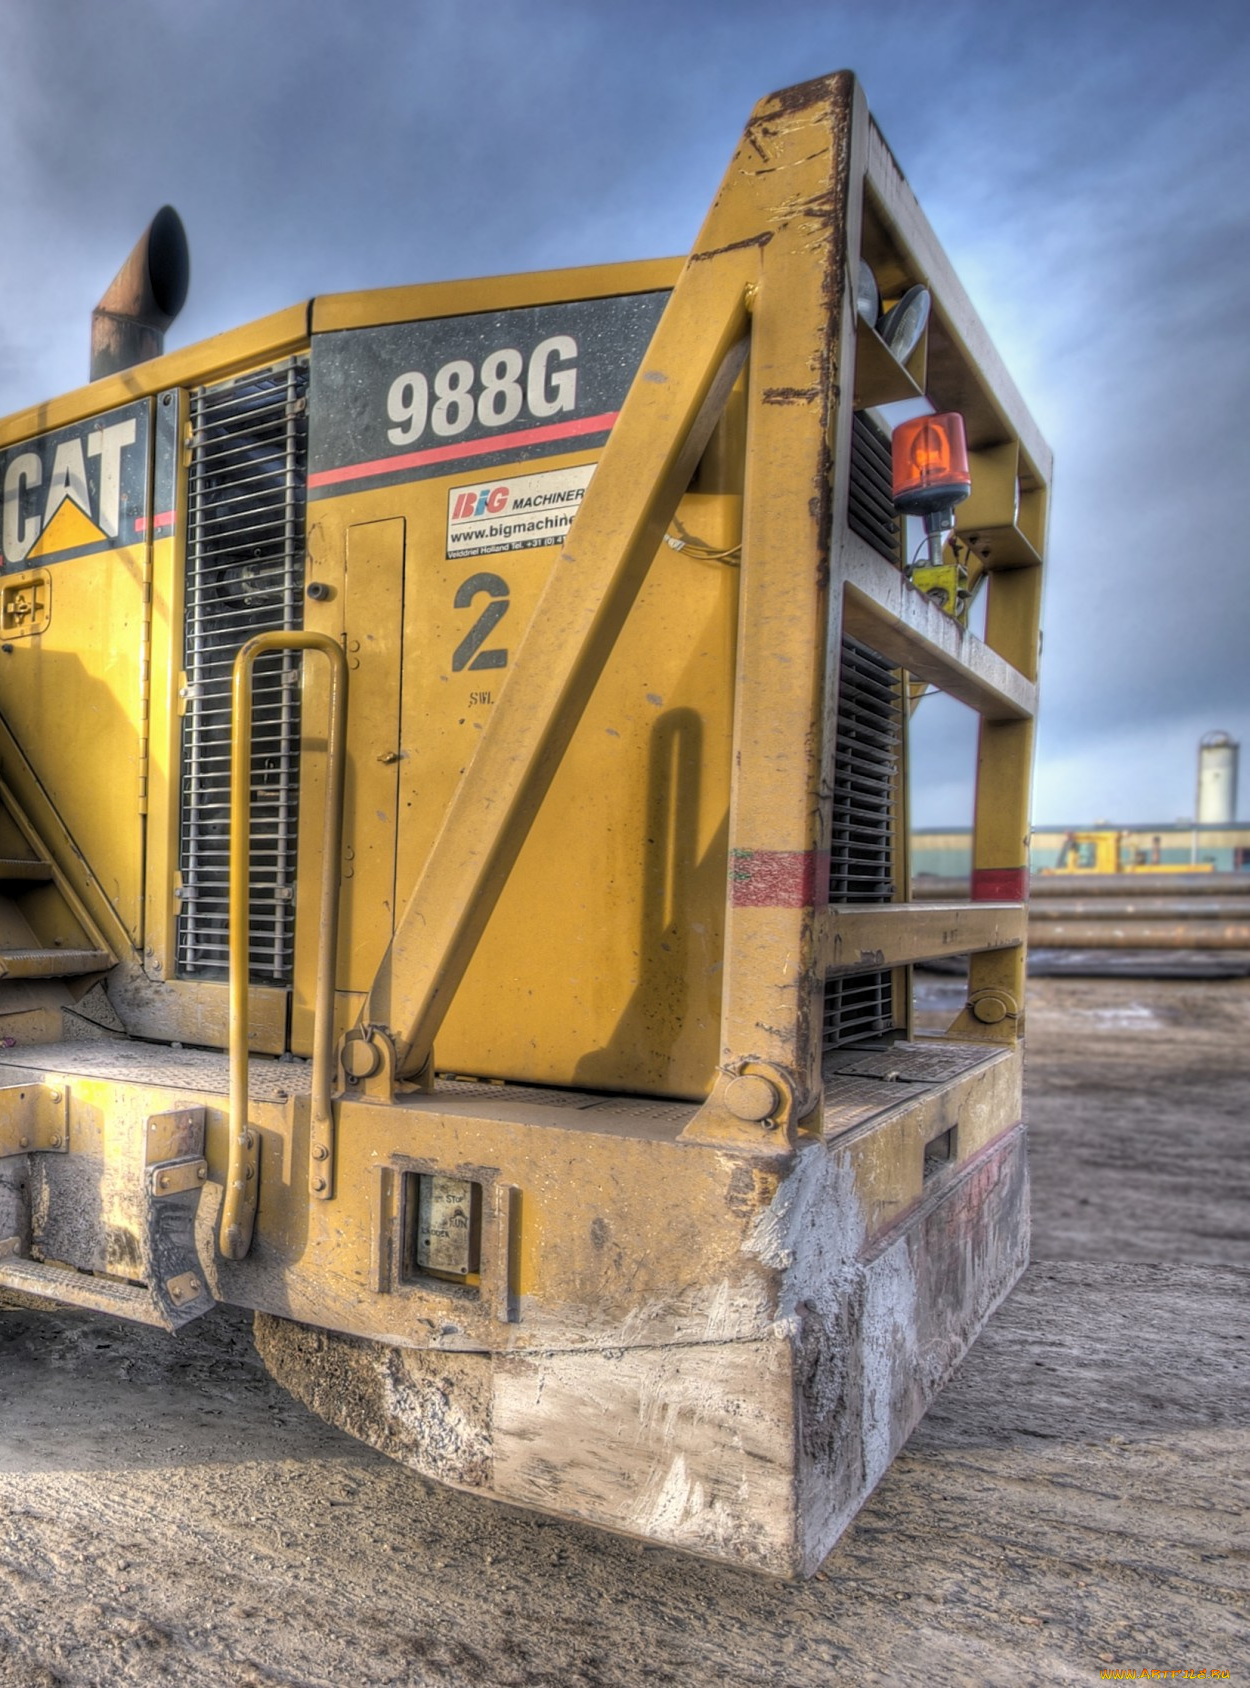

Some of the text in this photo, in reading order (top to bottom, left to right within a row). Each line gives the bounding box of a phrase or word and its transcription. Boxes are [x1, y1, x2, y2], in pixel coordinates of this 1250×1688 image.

[386, 334, 579, 446] 988G
[3, 418, 137, 563] CAT
[512, 488, 586, 511] MACHINER
[450, 514, 576, 543] www.bigmachin
[480, 543, 510, 554] Holland
[511, 542, 524, 550] Tel.
[526, 539, 542, 548] +31
[544, 537, 555, 547] (0)
[451, 572, 510, 672] 2
